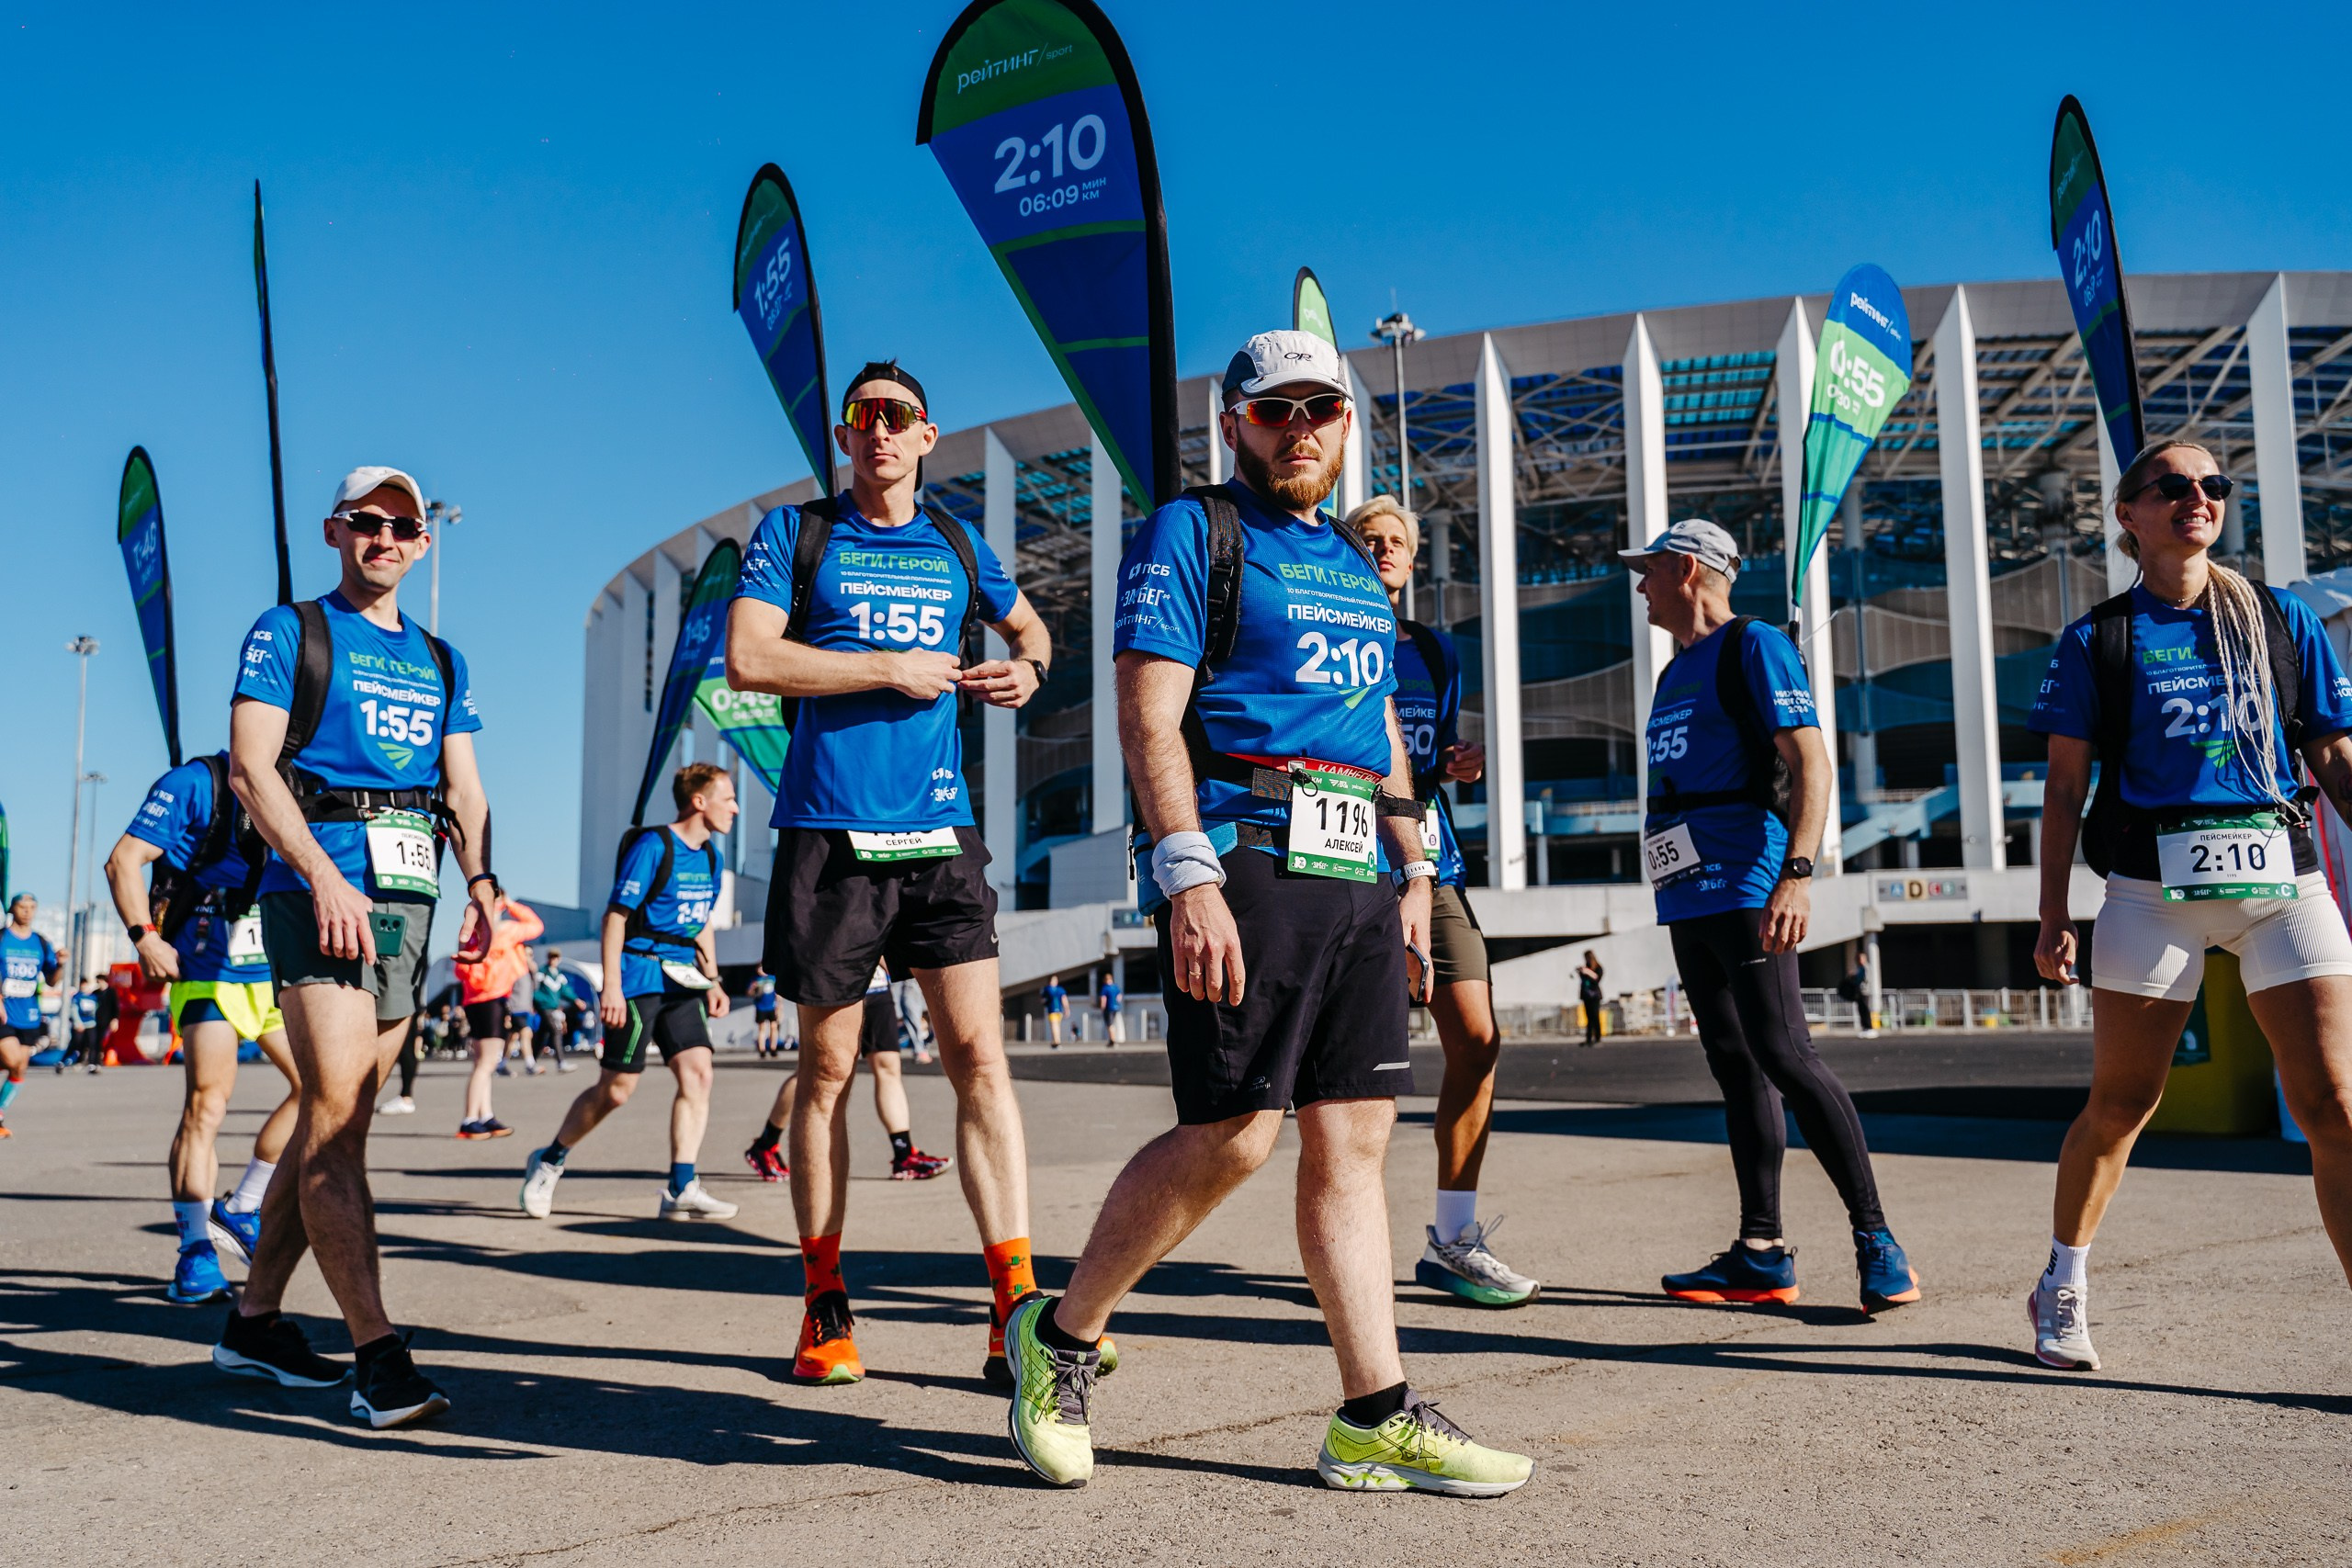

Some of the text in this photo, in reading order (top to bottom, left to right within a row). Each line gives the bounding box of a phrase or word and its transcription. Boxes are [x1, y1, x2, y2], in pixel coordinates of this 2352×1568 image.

[994, 114, 1106, 194] 2:10
[1019, 185, 1079, 217] 06:09
[2073, 209, 2102, 290] 2:10
[753, 236, 792, 320] 1:55
[1830, 340, 1885, 408] 0:55
[888, 556, 950, 573] ГЕРОЙ!
[1142, 563, 1170, 577] ПСБ
[840, 581, 953, 602] ПЕЙСМЕЙКЕР
[1295, 588, 1356, 605] БЛАГОТВОРИТЕЛЬНЫЙ
[848, 602, 945, 646] 1:55
[1287, 603, 1393, 635] ПЕЙСМЕЙКЕР
[1295, 631, 1385, 688] 2:10
[353, 680, 441, 707] ПЕЙСМЕЙКЕР
[359, 699, 435, 747] 1:55
[2161, 693, 2266, 739] 2:10
[1401, 724, 1435, 755] 50
[1316, 797, 1368, 838] 1196
[886, 837, 922, 846] СЕРГЕЙ
[1324, 838, 1363, 854] АЛЕКСЕЙ
[2199, 832, 2252, 841] ПЕЙСМЕЙКЕР
[396, 840, 432, 871] 1:55
[1647, 840, 1679, 871] 0:55
[2189, 843, 2267, 874] 2:10
